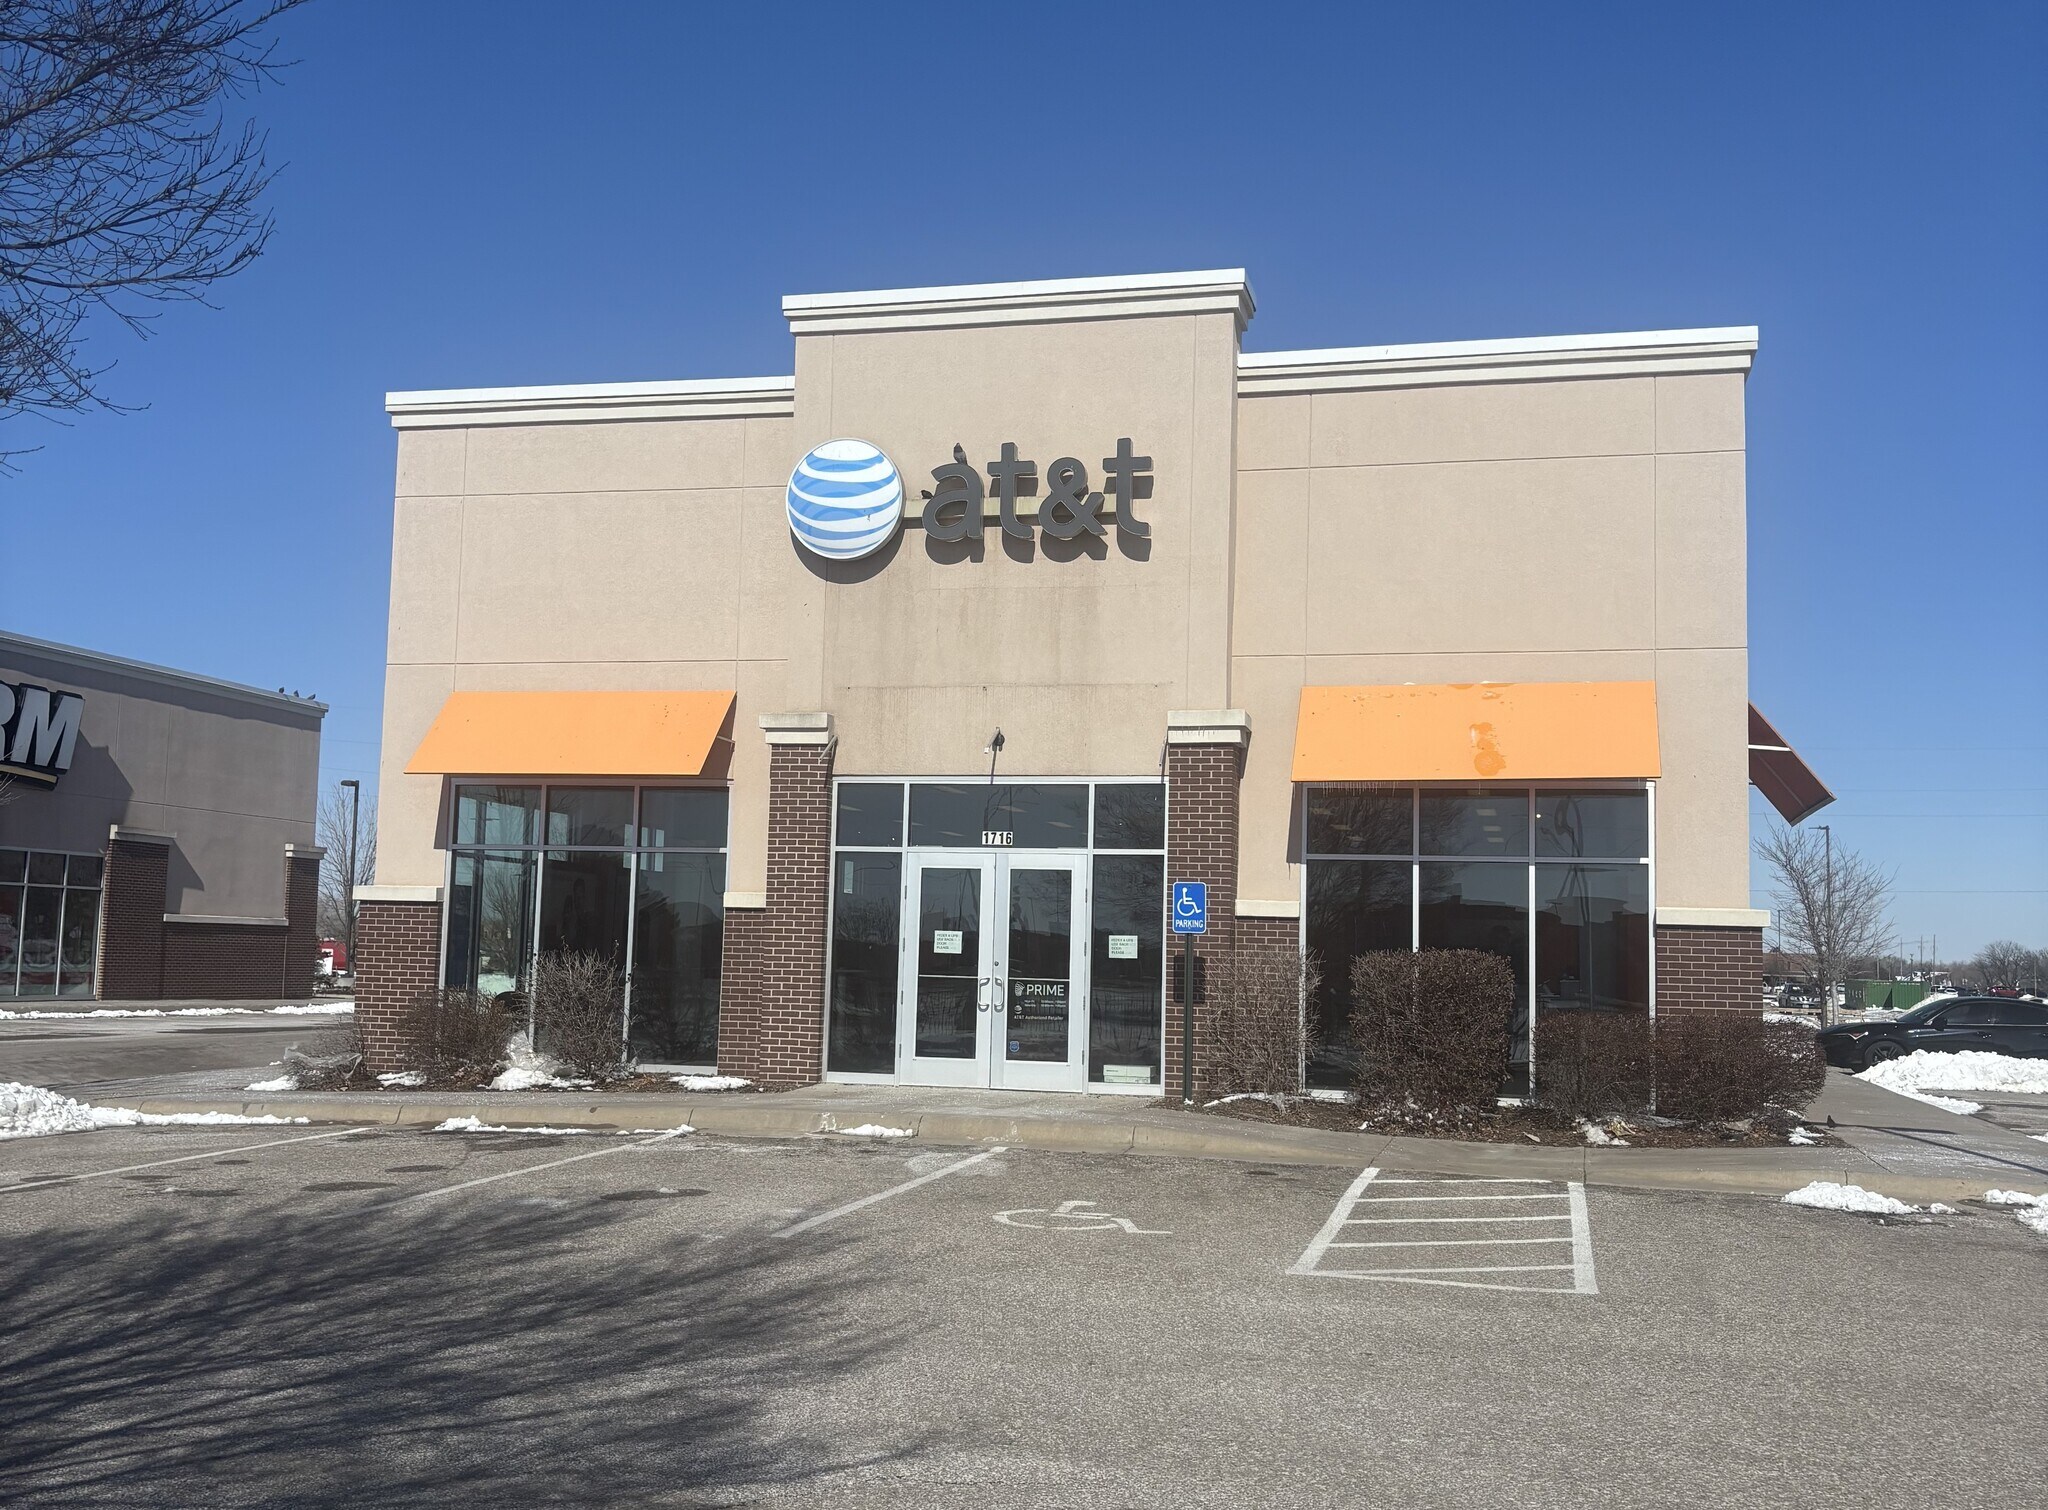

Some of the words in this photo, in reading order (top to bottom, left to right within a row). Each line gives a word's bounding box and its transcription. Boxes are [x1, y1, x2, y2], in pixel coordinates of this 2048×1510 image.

[922, 438, 1153, 541] at&t
[983, 831, 1012, 845] 1716
[1175, 919, 1204, 928] PARKING
[1026, 984, 1065, 996] PRIME
